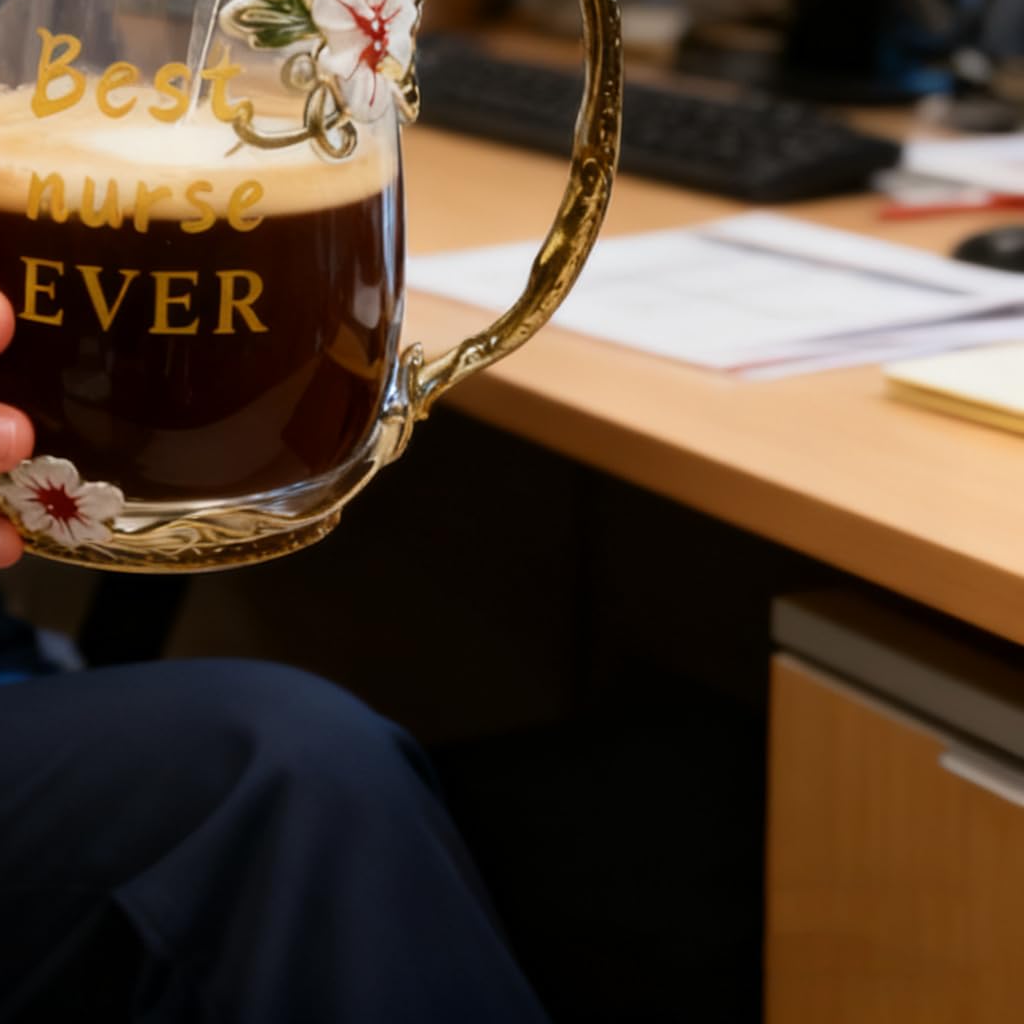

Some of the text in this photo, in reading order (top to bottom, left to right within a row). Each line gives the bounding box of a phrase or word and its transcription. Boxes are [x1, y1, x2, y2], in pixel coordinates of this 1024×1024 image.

[31, 27, 254, 124] Best
[26, 171, 265, 234] nurse
[18, 256, 270, 335] EVER
